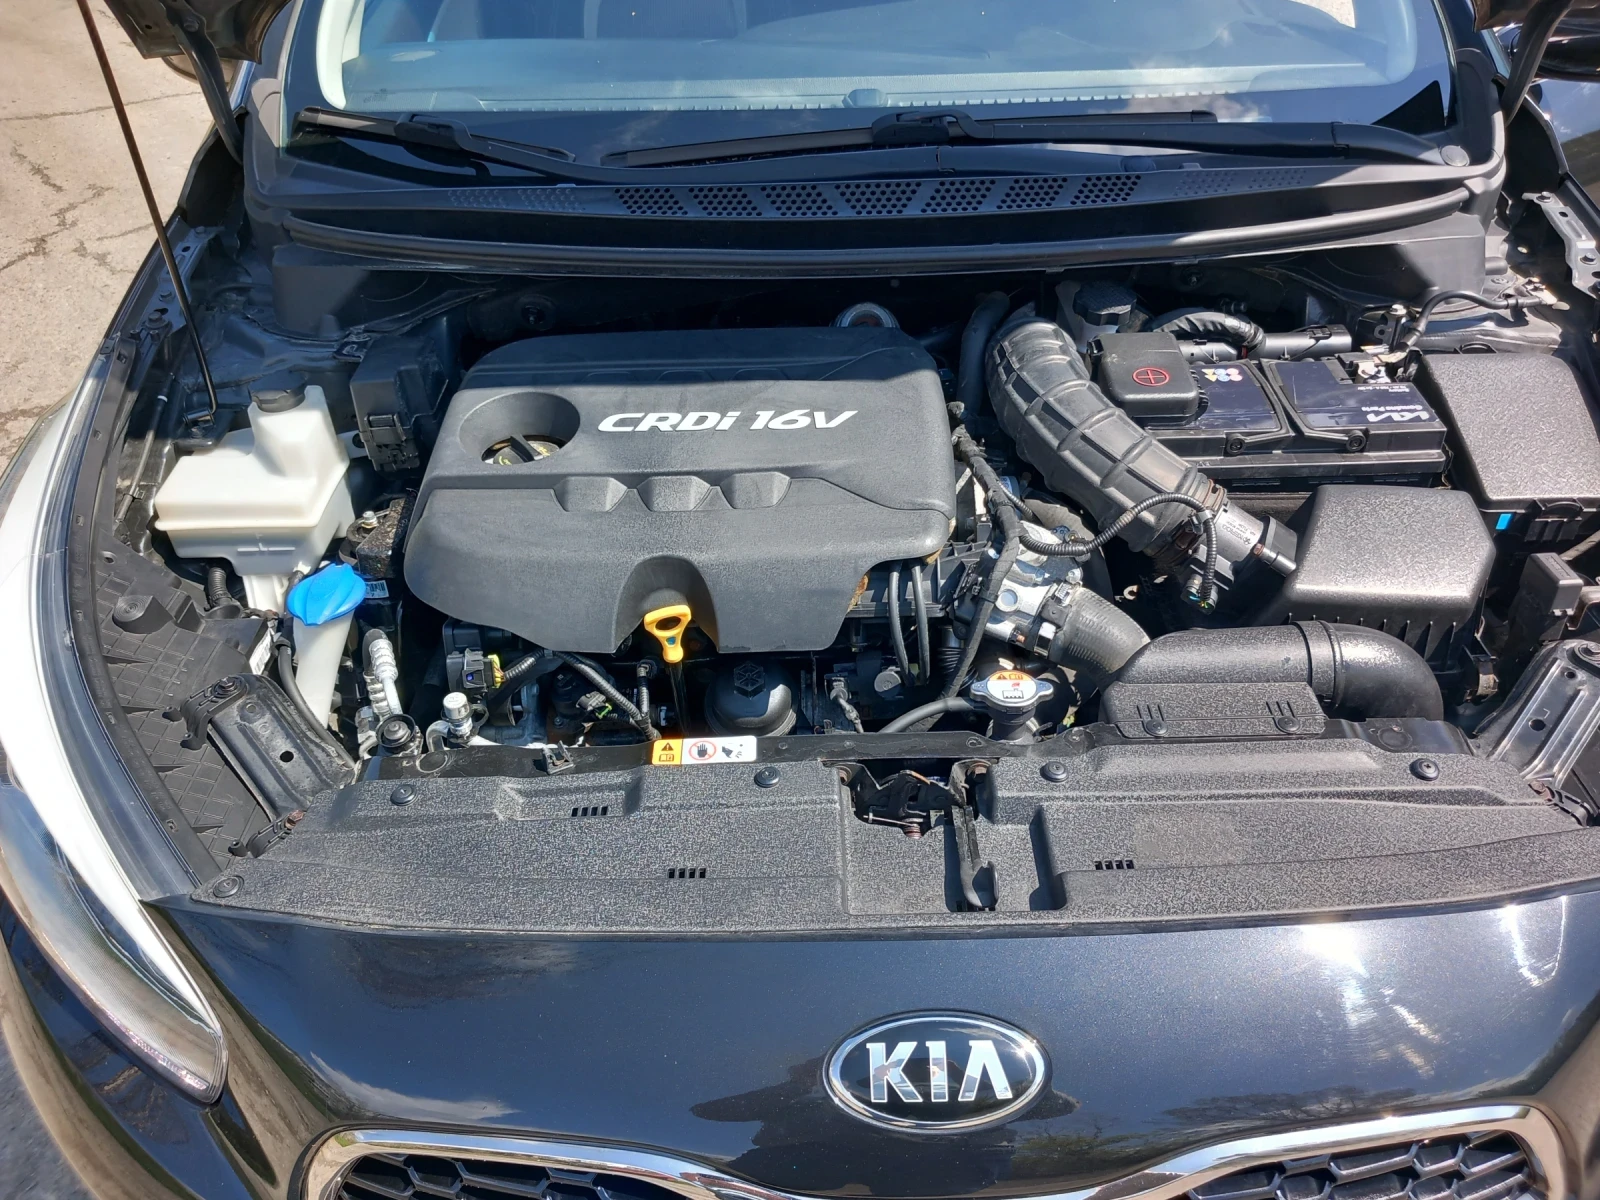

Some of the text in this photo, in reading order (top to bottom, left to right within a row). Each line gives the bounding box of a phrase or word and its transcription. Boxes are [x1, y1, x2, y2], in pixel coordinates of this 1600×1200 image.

[598, 409, 858, 432] CRDi 16V
[1366, 411, 1429, 422] KIA
[866, 1040, 1013, 1102] KIA
